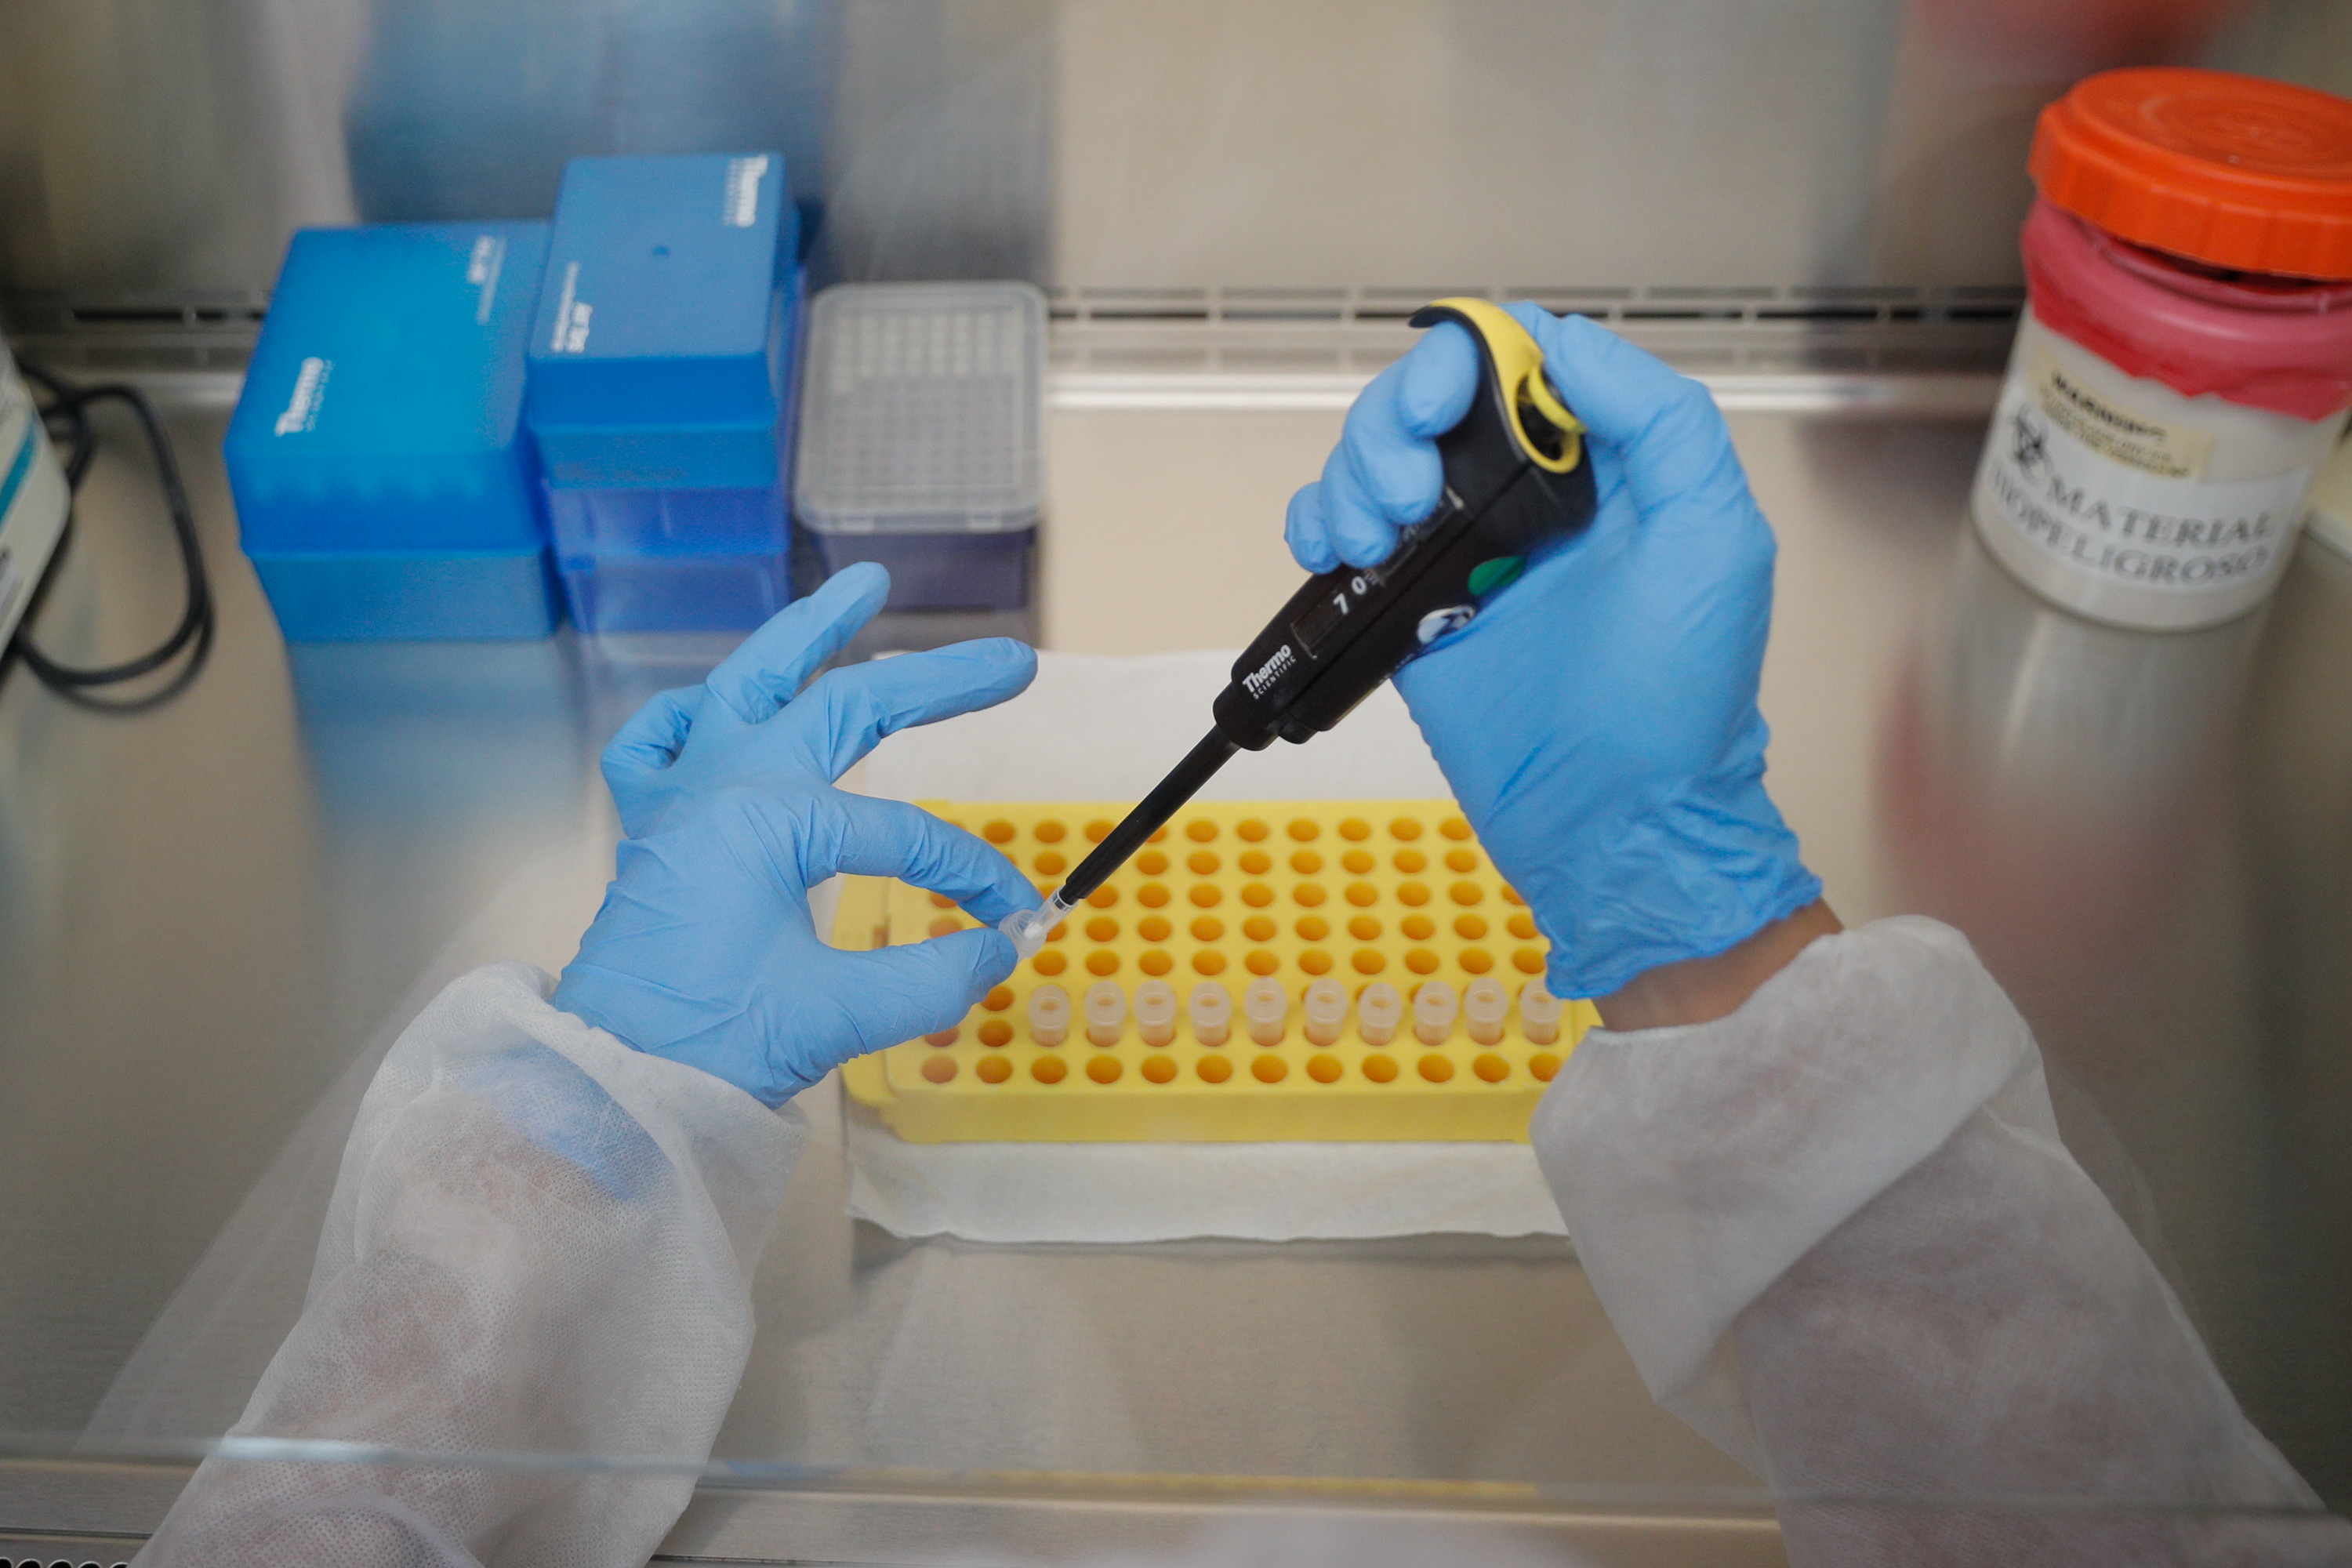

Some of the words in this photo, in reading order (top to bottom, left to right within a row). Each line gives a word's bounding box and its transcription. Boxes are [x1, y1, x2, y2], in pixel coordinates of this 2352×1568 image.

[2046, 474, 2272, 546] MATERIAL
[1242, 644, 1291, 692] Thermo
[1253, 655, 1296, 699] SCIENTIFIC
